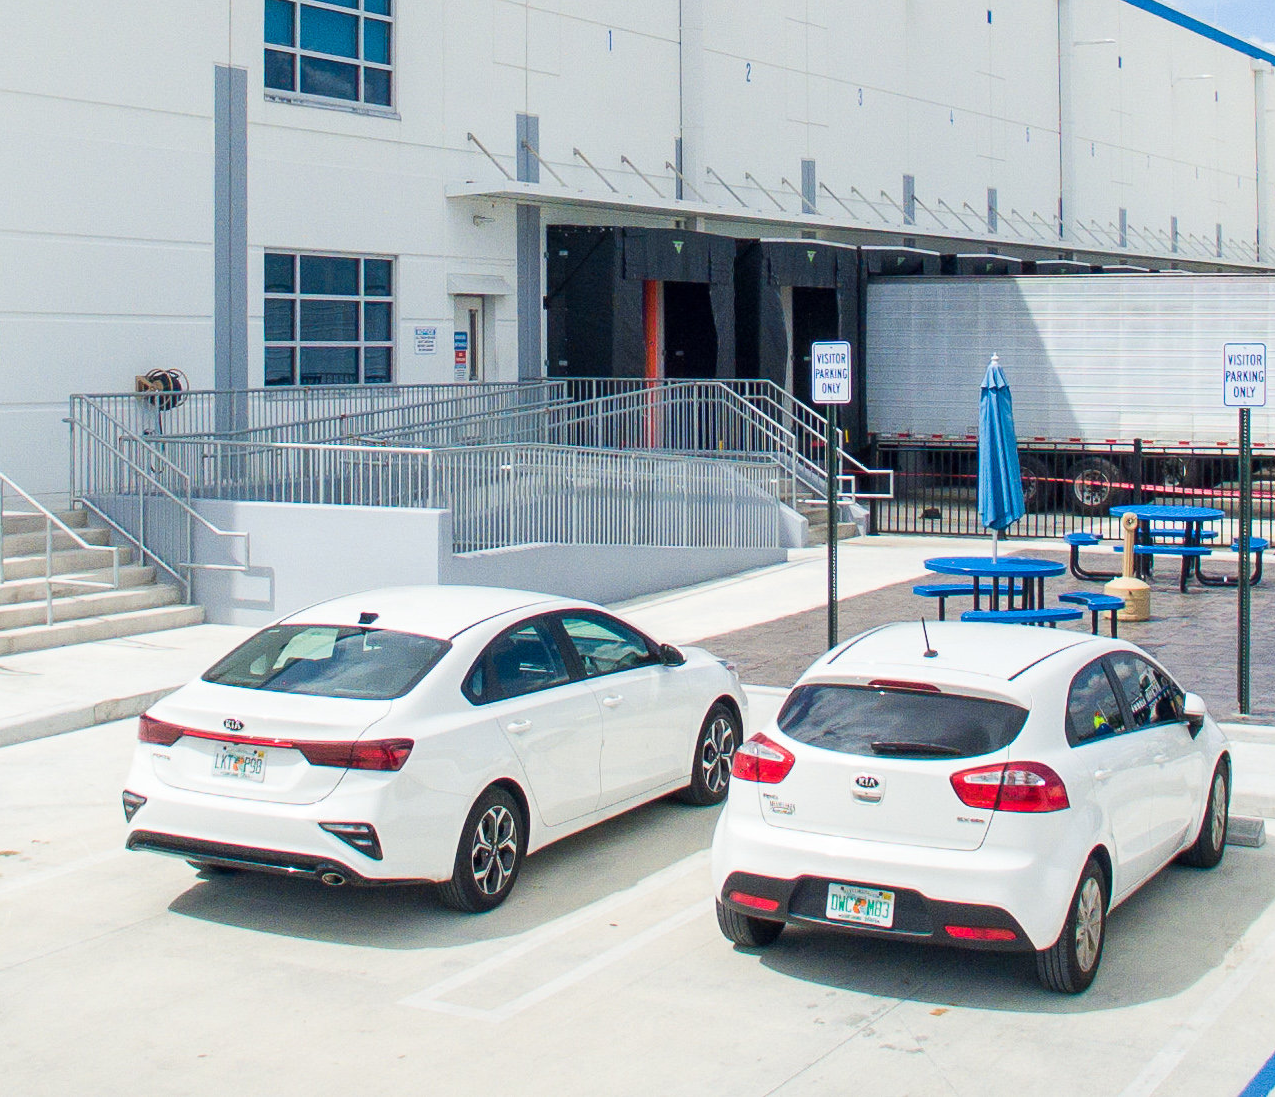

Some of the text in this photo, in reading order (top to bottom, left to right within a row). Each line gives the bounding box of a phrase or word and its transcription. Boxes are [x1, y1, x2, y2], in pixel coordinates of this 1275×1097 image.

[608, 30, 612, 51] 1
[746, 62, 751, 82] 2
[858, 88, 863, 106] 3
[817, 353, 846, 364] VISITOR
[1228, 354, 1262, 366] VISITOR
[815, 369, 847, 379] PARKING
[1226, 370, 1264, 382] PARKING
[822, 383, 840, 394] ONLY
[1234, 386, 1255, 398] ONLY
[225, 719, 242, 730] KIA
[214, 753, 234, 770] LKT
[857, 777, 877, 788] KIA
[831, 894, 890, 919] DWC M83
